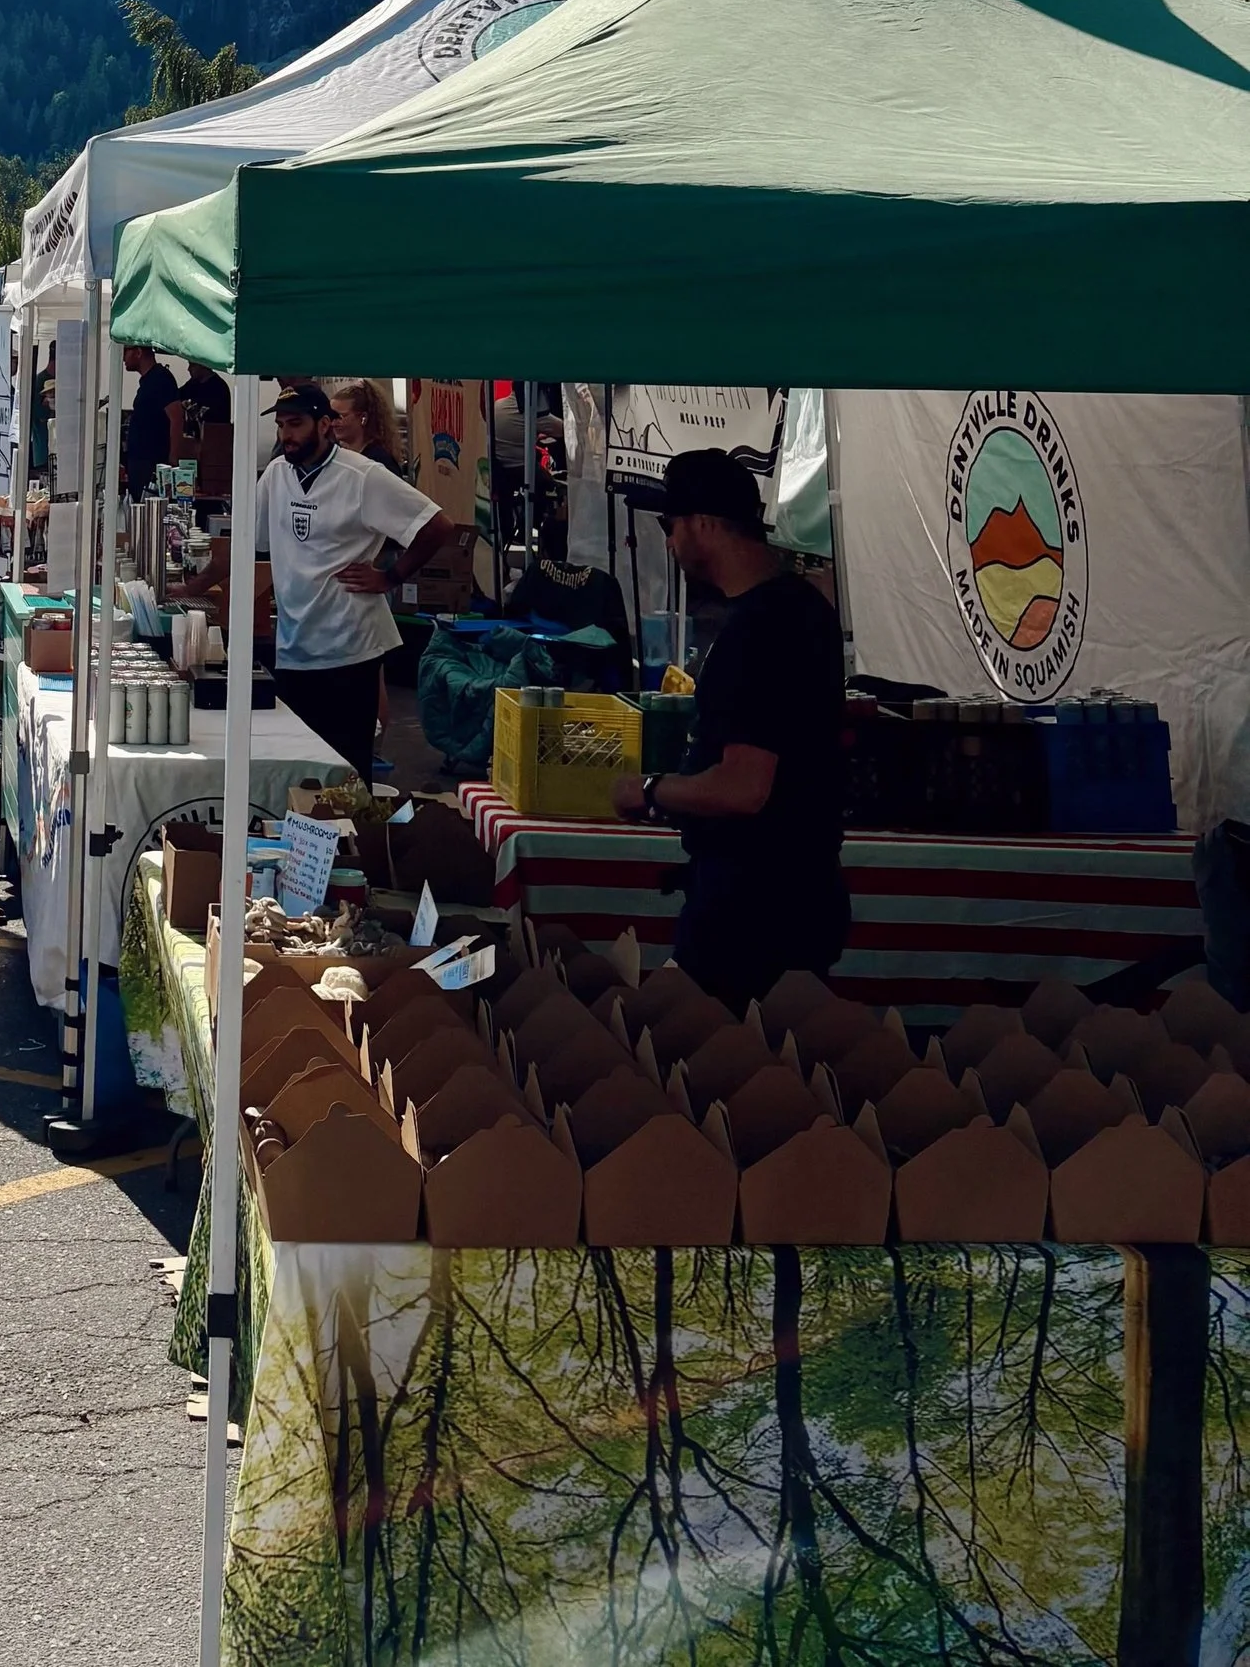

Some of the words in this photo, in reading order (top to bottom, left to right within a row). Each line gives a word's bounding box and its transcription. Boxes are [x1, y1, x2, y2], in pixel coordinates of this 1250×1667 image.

[679, 412, 700, 426] MEAL
[704, 415, 726, 429] PREP
[950, 390, 1017, 523] DENTVILLE
[1023, 399, 1080, 543] DRINKS
[290, 501, 318, 511] UMBRO
[955, 568, 993, 656] MADE
[992, 647, 1010, 680] IN
[1014, 591, 1081, 696] SQUAMISH
[291, 819, 333, 841] MUSHROOMS
